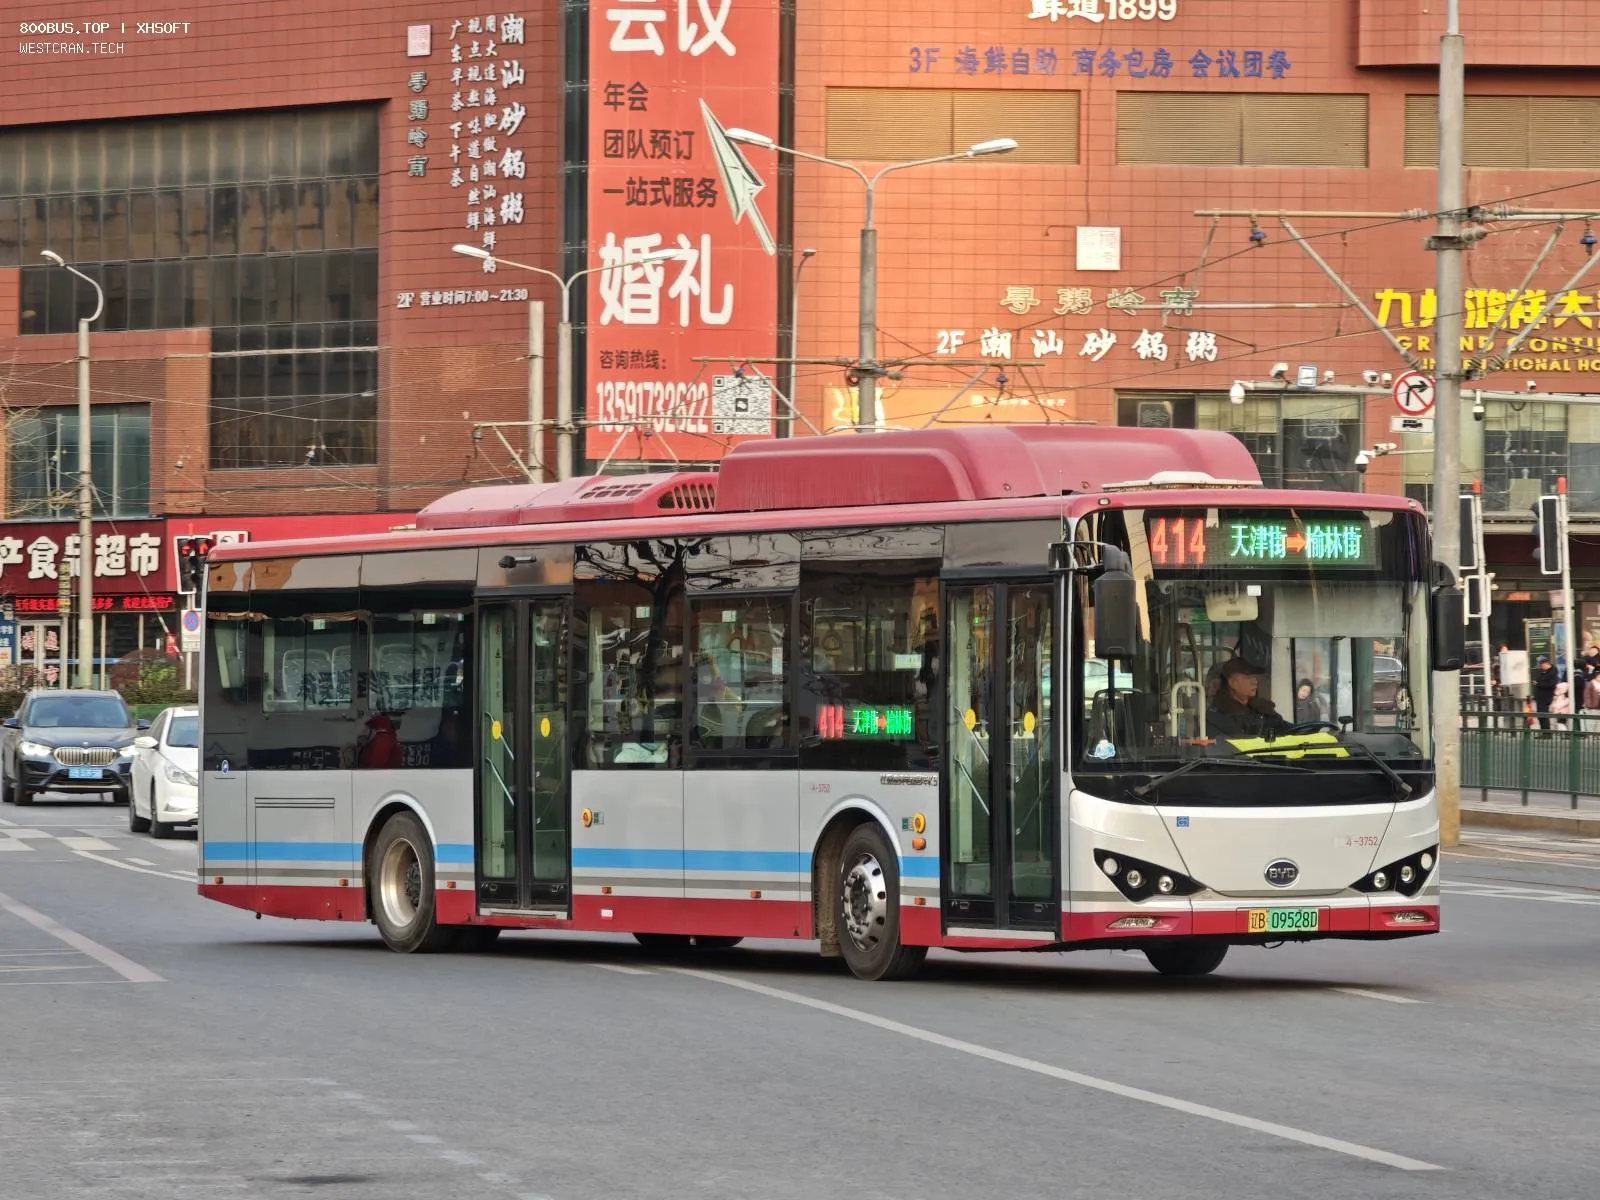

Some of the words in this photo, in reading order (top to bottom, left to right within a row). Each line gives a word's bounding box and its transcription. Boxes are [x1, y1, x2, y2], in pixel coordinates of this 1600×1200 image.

[605, 0, 736, 56] 会议
[909, 46, 940, 73] 3F
[954, 45, 1057, 76] 海鲜自助
[1072, 47, 1174, 78] 商务包房
[1187, 48, 1292, 80] 会议团餐
[603, 81, 648, 112] 年会
[498, 13, 526, 225] 潮汕砂锅粥
[603, 129, 695, 160] 团队预订
[603, 176, 718, 208] 一站式服务
[599, 232, 734, 327] 婚礼
[396, 292, 415, 308] 2F
[1374, 288, 1600, 330] 九鸿祥大
[936, 330, 965, 355] 2F
[980, 327, 1218, 362] 潮汕砂锅粥
[1396, 335, 1495, 352] GRND
[1506, 336, 1600, 353] ONTI
[596, 381, 709, 433] 13591732622
[1151, 517, 1206, 565] 414
[1230, 524, 1288, 559] 天津街
[1305, 525, 1362, 559] 榆林街
[1268, 867, 1296, 879] BYD
[1271, 911, 1318, 929] 09528D
